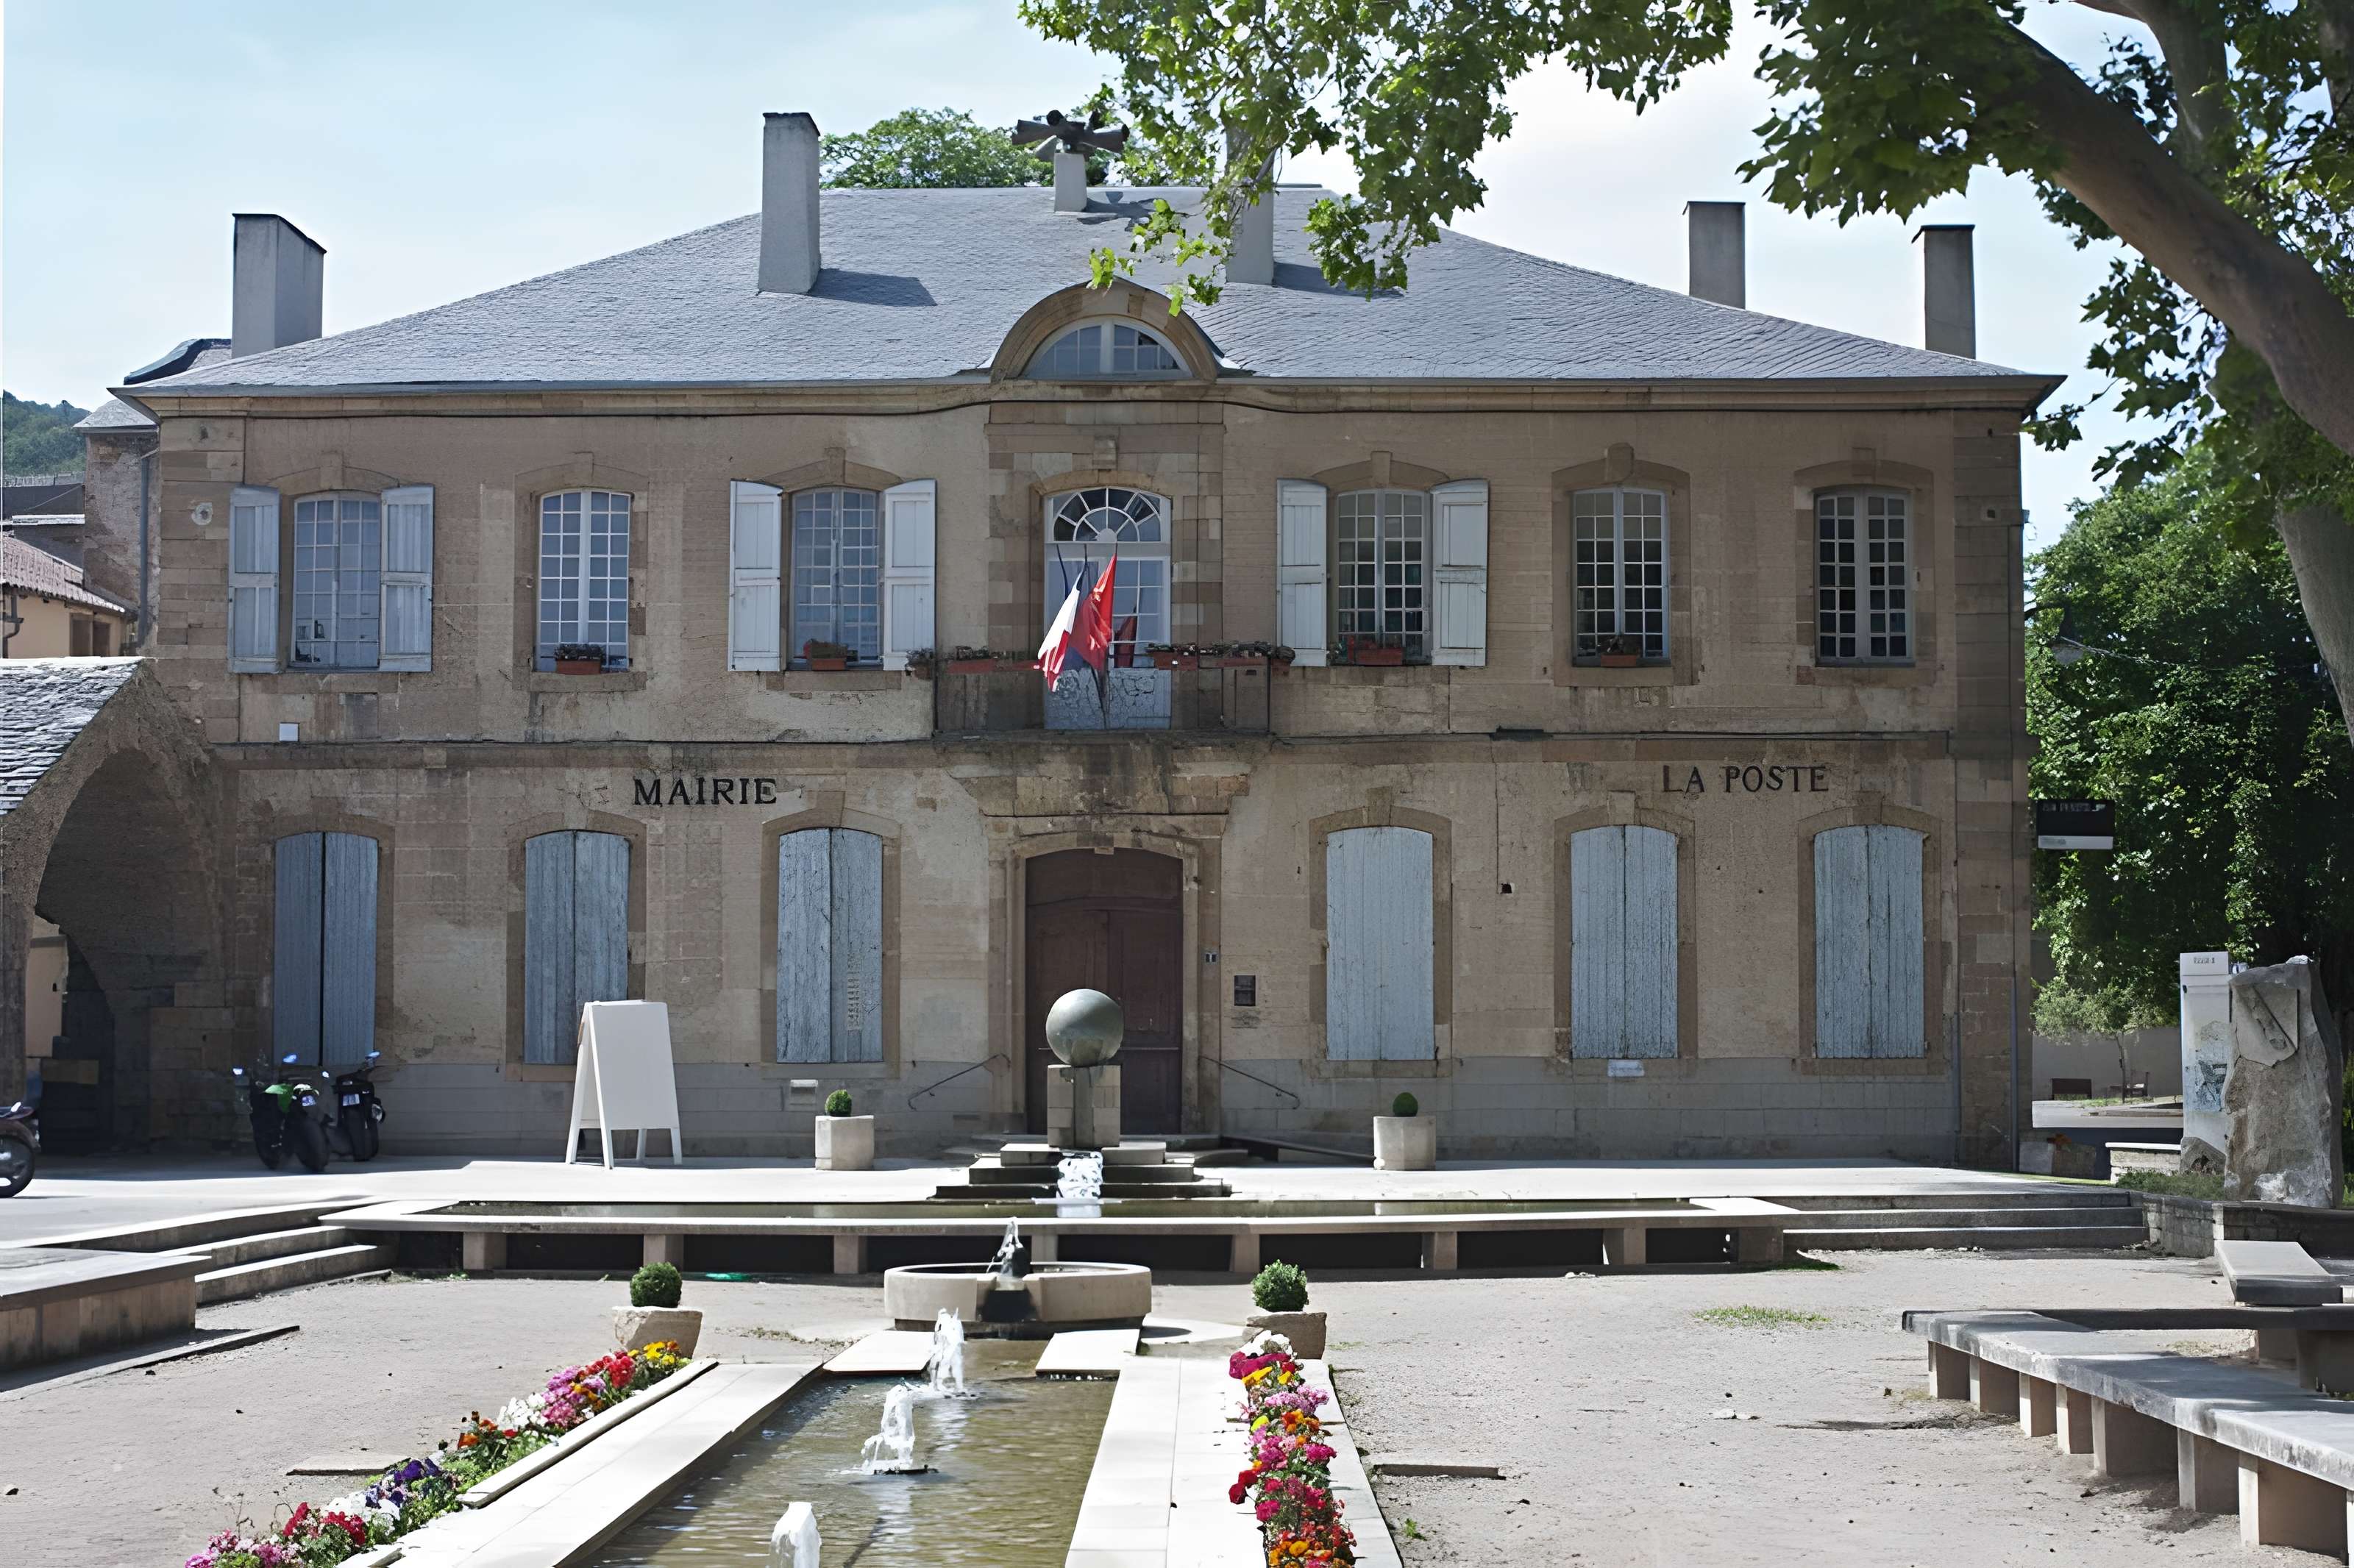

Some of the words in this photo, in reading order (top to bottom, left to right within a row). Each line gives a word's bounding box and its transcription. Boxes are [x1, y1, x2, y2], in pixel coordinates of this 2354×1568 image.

[633, 777, 777, 805] MAIRIE
[1663, 765, 1705, 793] LA
[1720, 765, 1829, 793] POSTE
